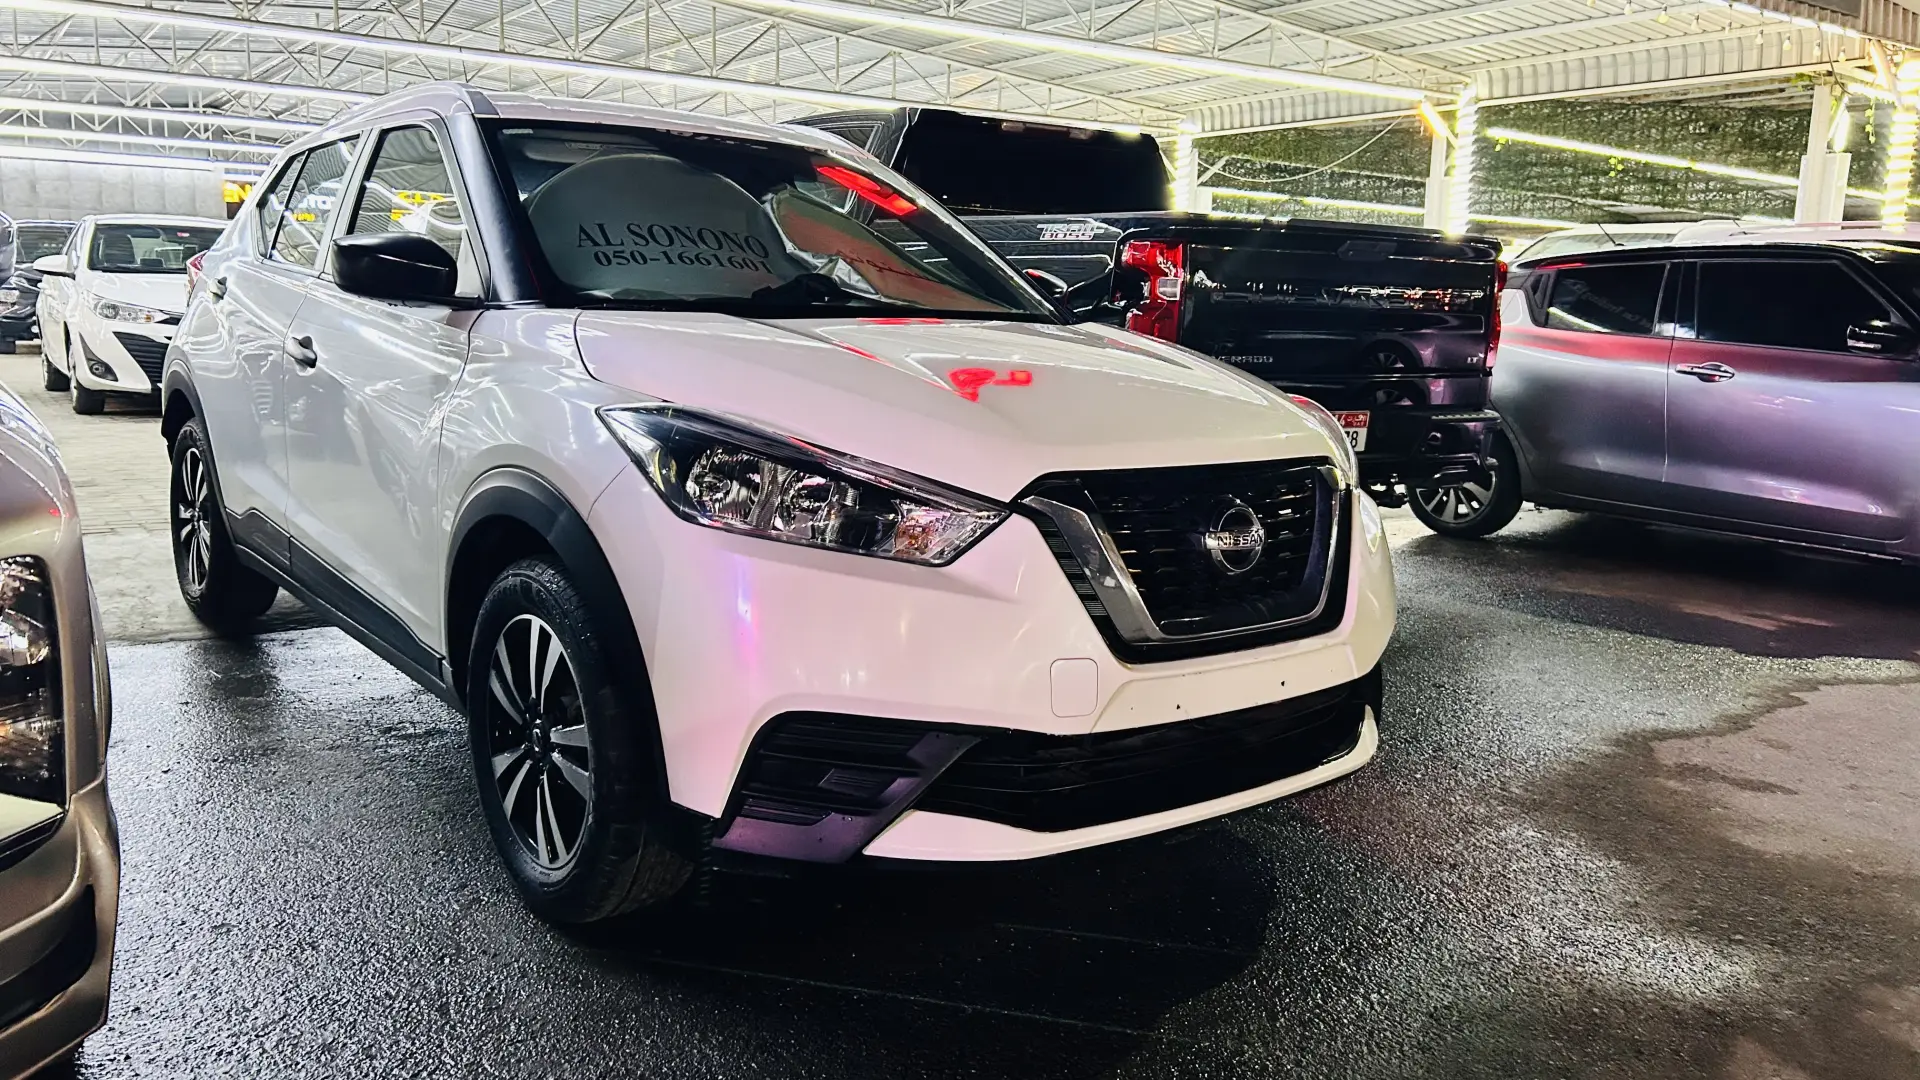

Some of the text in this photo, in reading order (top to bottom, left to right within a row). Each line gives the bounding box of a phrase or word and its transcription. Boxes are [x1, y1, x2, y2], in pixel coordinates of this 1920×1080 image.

[1037, 223, 1105, 233] TRAIL
[1040, 231, 1095, 241] BOSS
[576, 222, 770, 259] AL SONONO
[593, 249, 774, 275] 050-1661601
[1217, 531, 1263, 548] NISSAN
